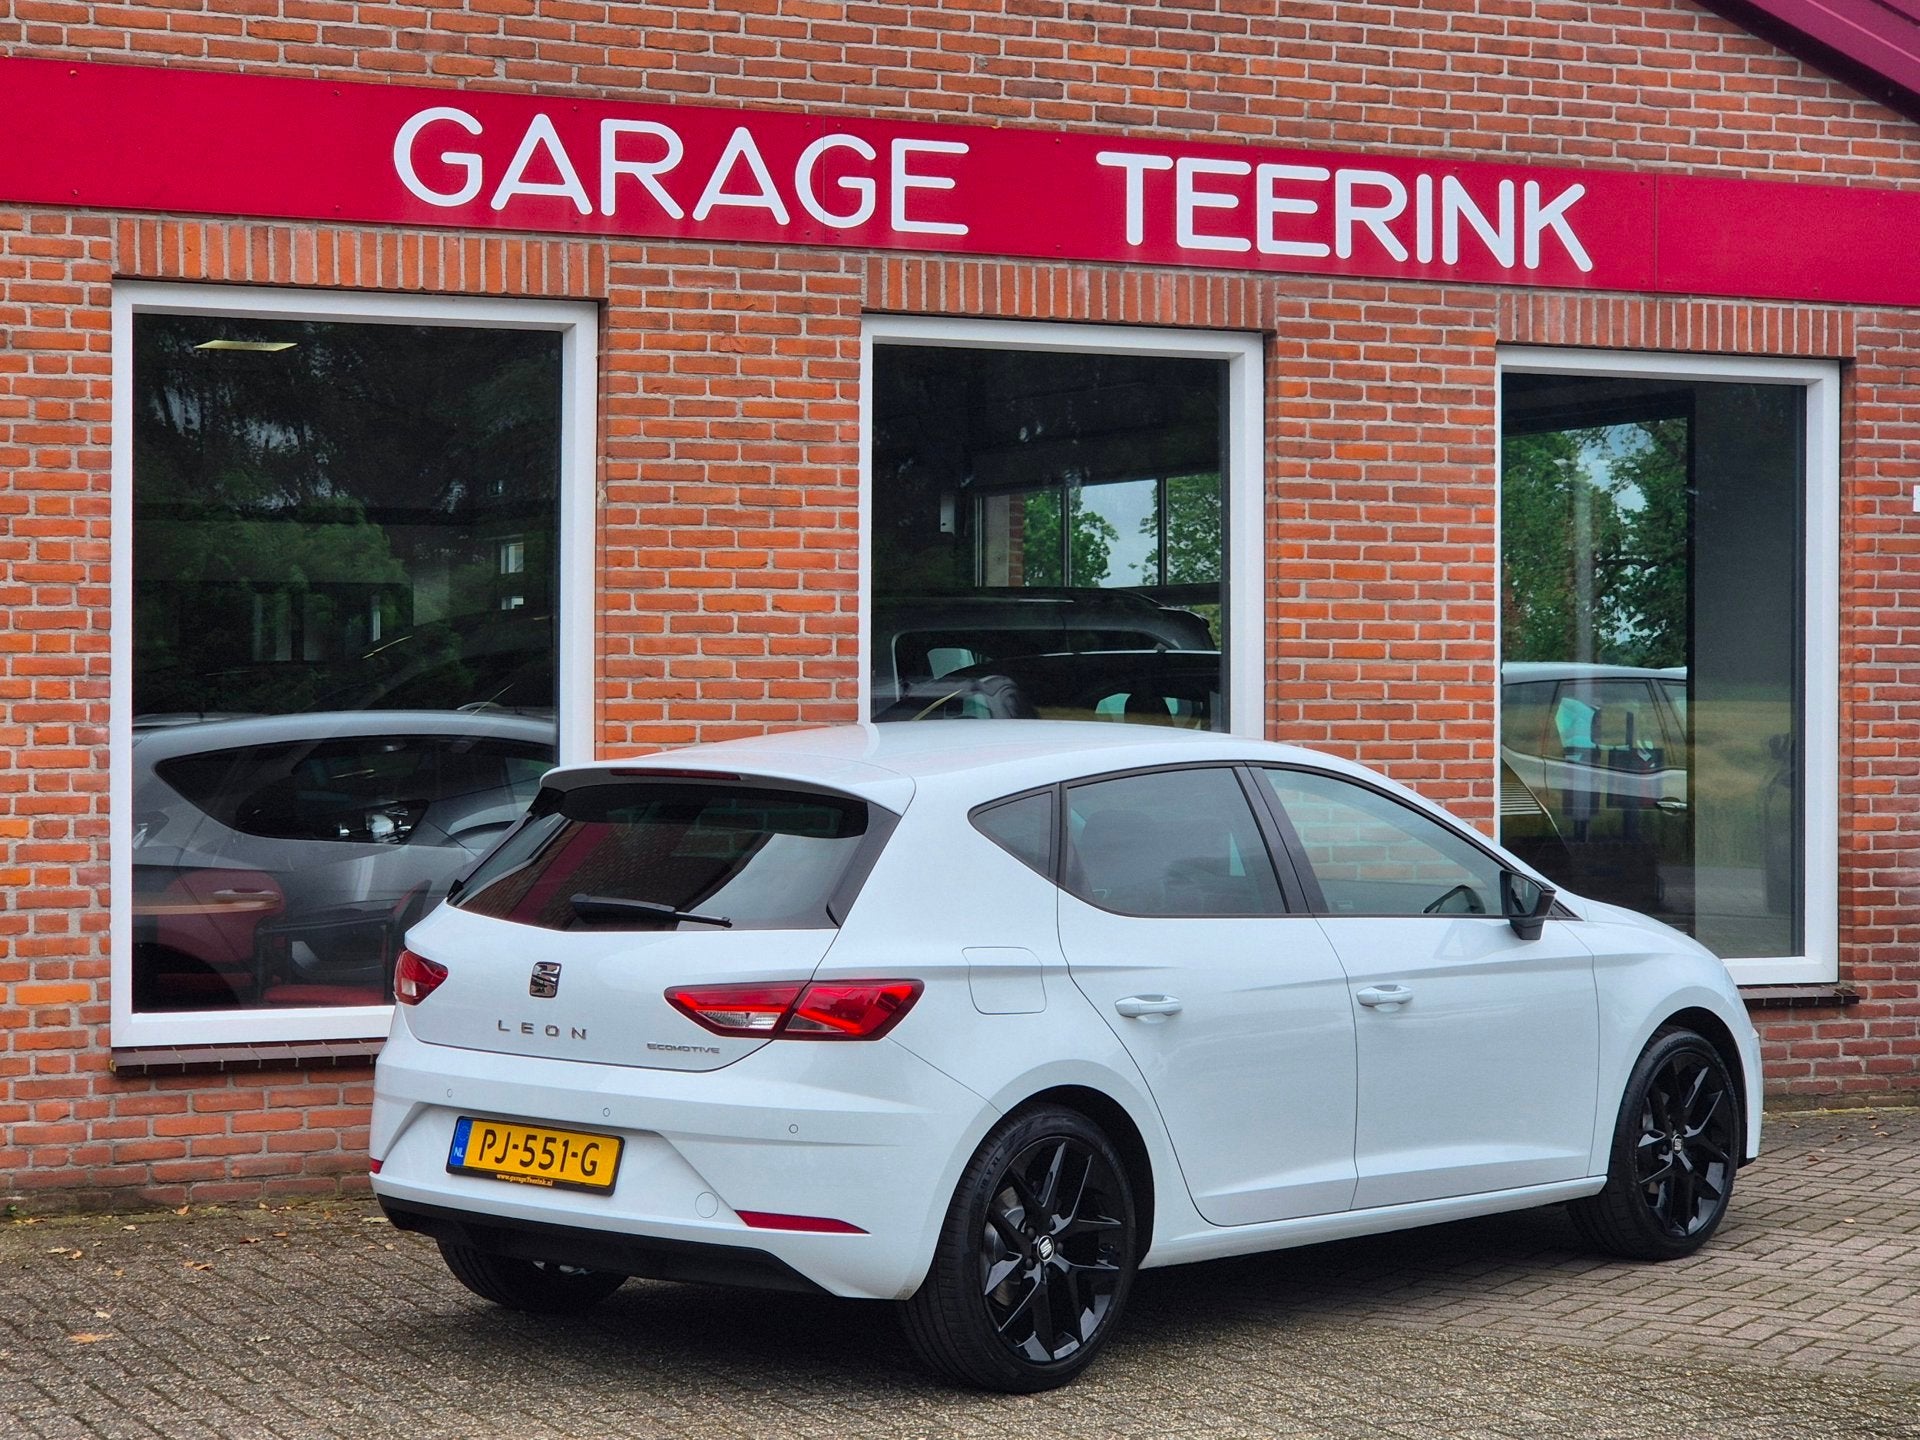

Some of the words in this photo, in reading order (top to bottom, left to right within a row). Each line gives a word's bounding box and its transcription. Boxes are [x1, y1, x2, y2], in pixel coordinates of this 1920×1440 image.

[393, 107, 969, 235] GARAGE
[1096, 151, 1593, 272] TEERINK
[497, 1019, 587, 1040] LEON
[646, 1041, 721, 1054] ECOMOTIVE
[453, 1146, 464, 1158] NL
[478, 1128, 600, 1177] PJ-551-G
